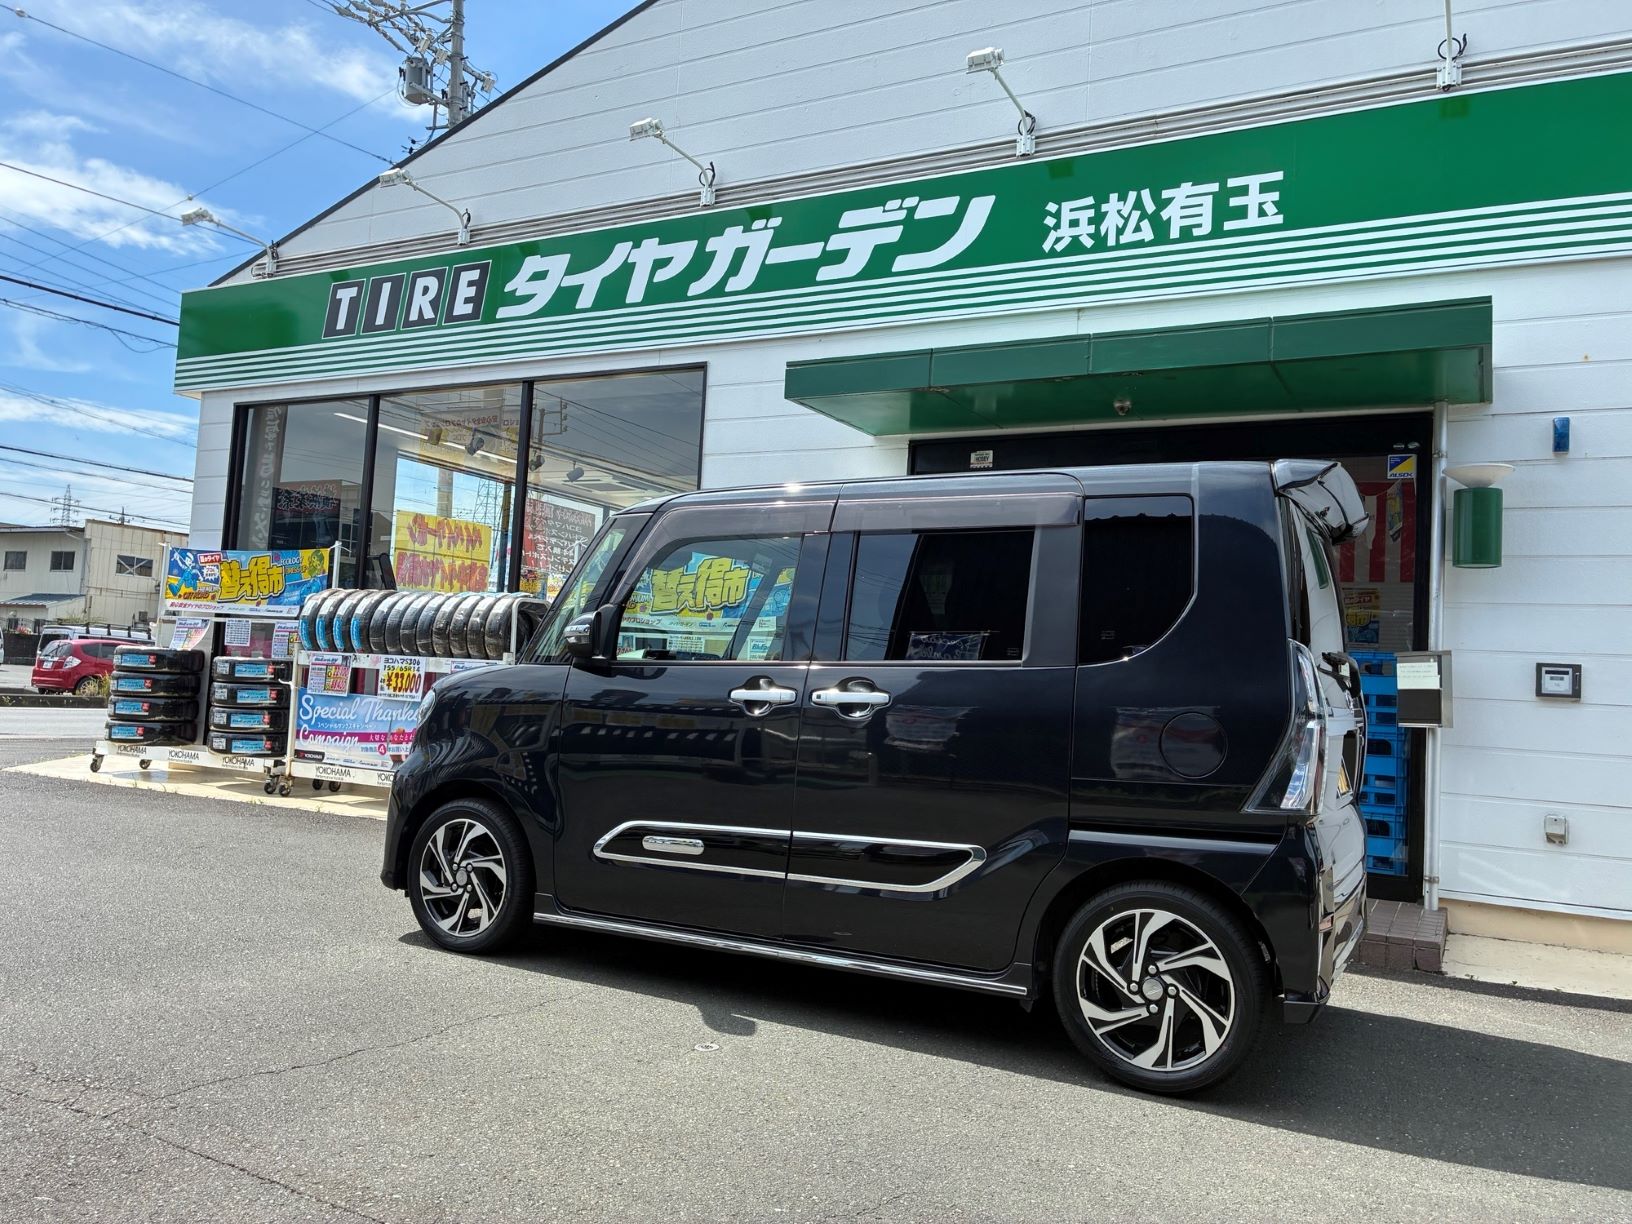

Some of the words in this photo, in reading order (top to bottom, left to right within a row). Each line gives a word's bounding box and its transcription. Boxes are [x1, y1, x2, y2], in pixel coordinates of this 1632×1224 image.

[1041, 170, 1284, 254] 浜松有玉
[495, 195, 996, 319] タイヤガーデン
[335, 268, 481, 331] TIRE
[219, 555, 285, 600] 替え得市
[651, 557, 750, 612] 替え得市
[383, 657, 421, 666] ヨコハマS306
[383, 664, 421, 673] 155/65R14
[299, 694, 360, 725] Special
[117, 745, 147, 755] YOKOHAMA
[168, 750, 200, 761] YOKOHAMA
[222, 756, 255, 767] YOKOHAMA
[315, 765, 352, 778] YOKOHAMA
